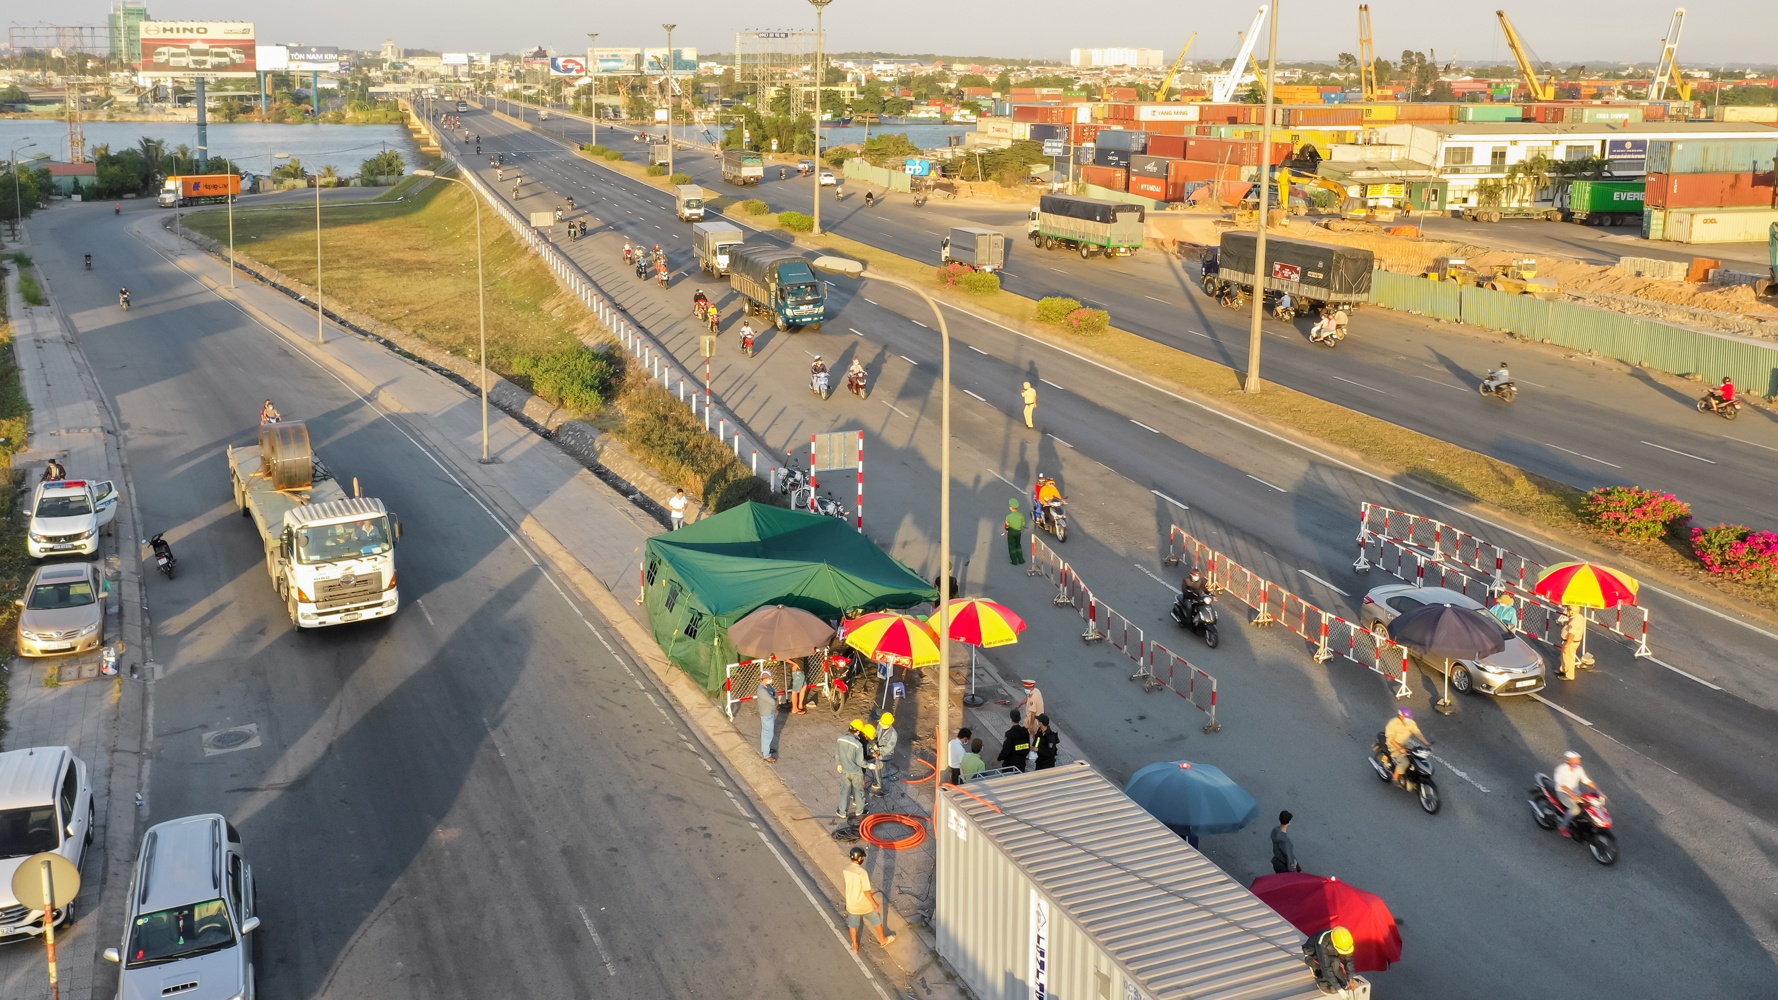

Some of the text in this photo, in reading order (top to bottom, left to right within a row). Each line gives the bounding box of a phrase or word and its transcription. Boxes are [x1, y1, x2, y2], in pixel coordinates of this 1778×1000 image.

[162, 26, 208, 35] HINO
[290, 52, 305, 60] TÔN
[1141, 183, 1162, 193] HYUNDAI
